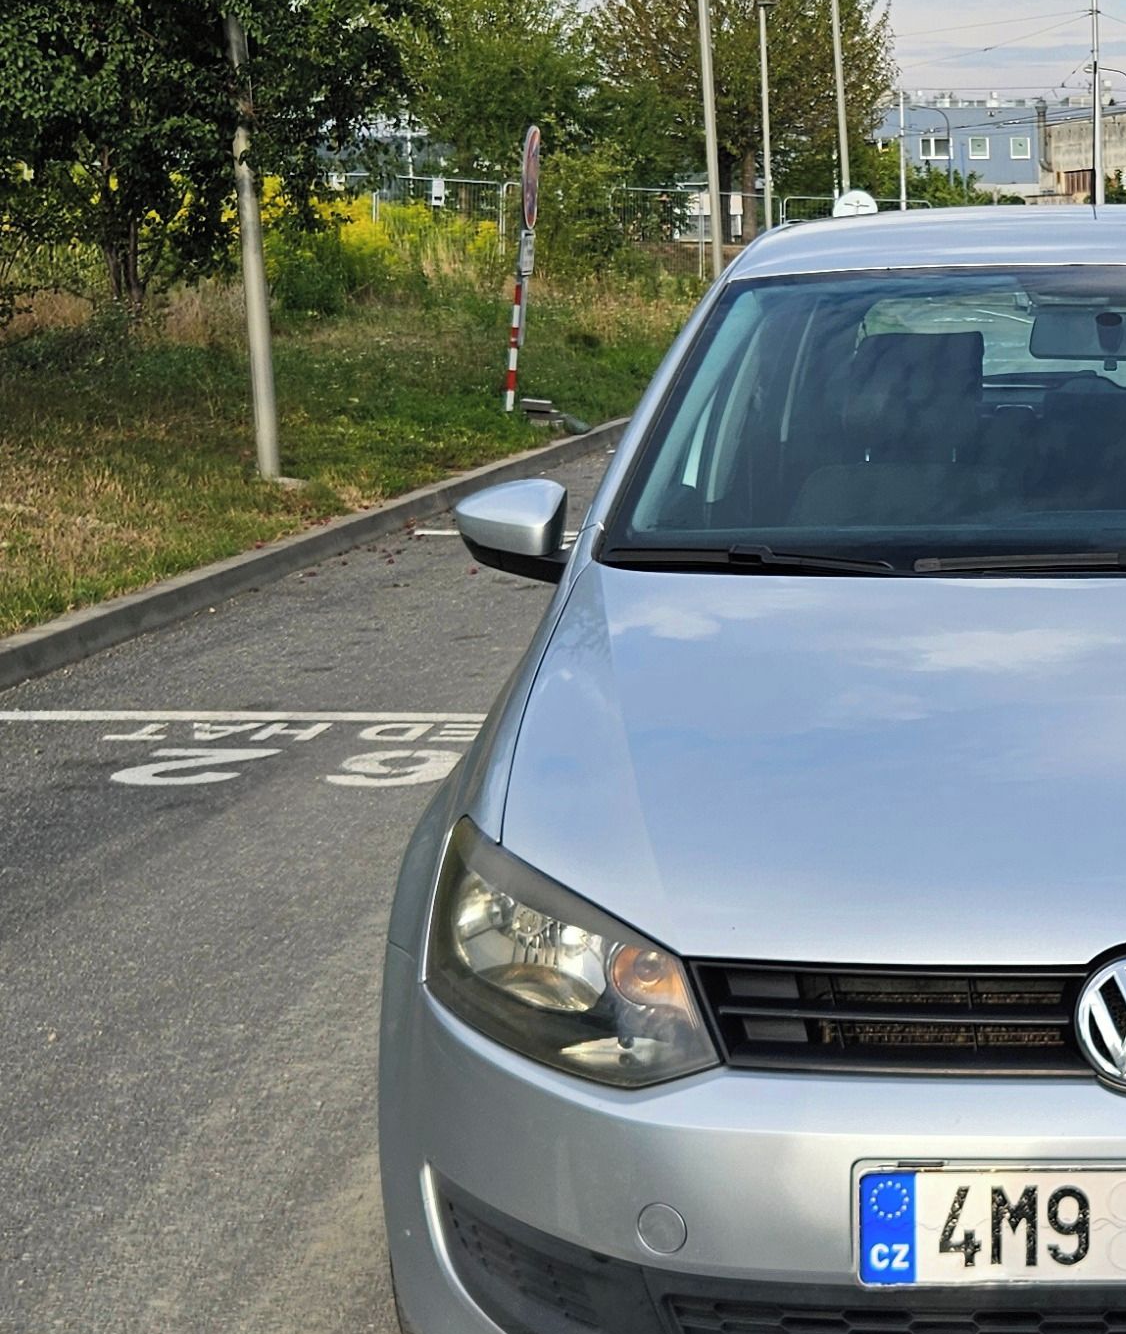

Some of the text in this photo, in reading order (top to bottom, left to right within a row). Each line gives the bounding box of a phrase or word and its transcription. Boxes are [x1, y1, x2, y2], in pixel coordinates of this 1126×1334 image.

[103, 722, 333, 741] HAT
[938, 1184, 1091, 1268] 4M9
[870, 1242, 910, 1270] CZ
